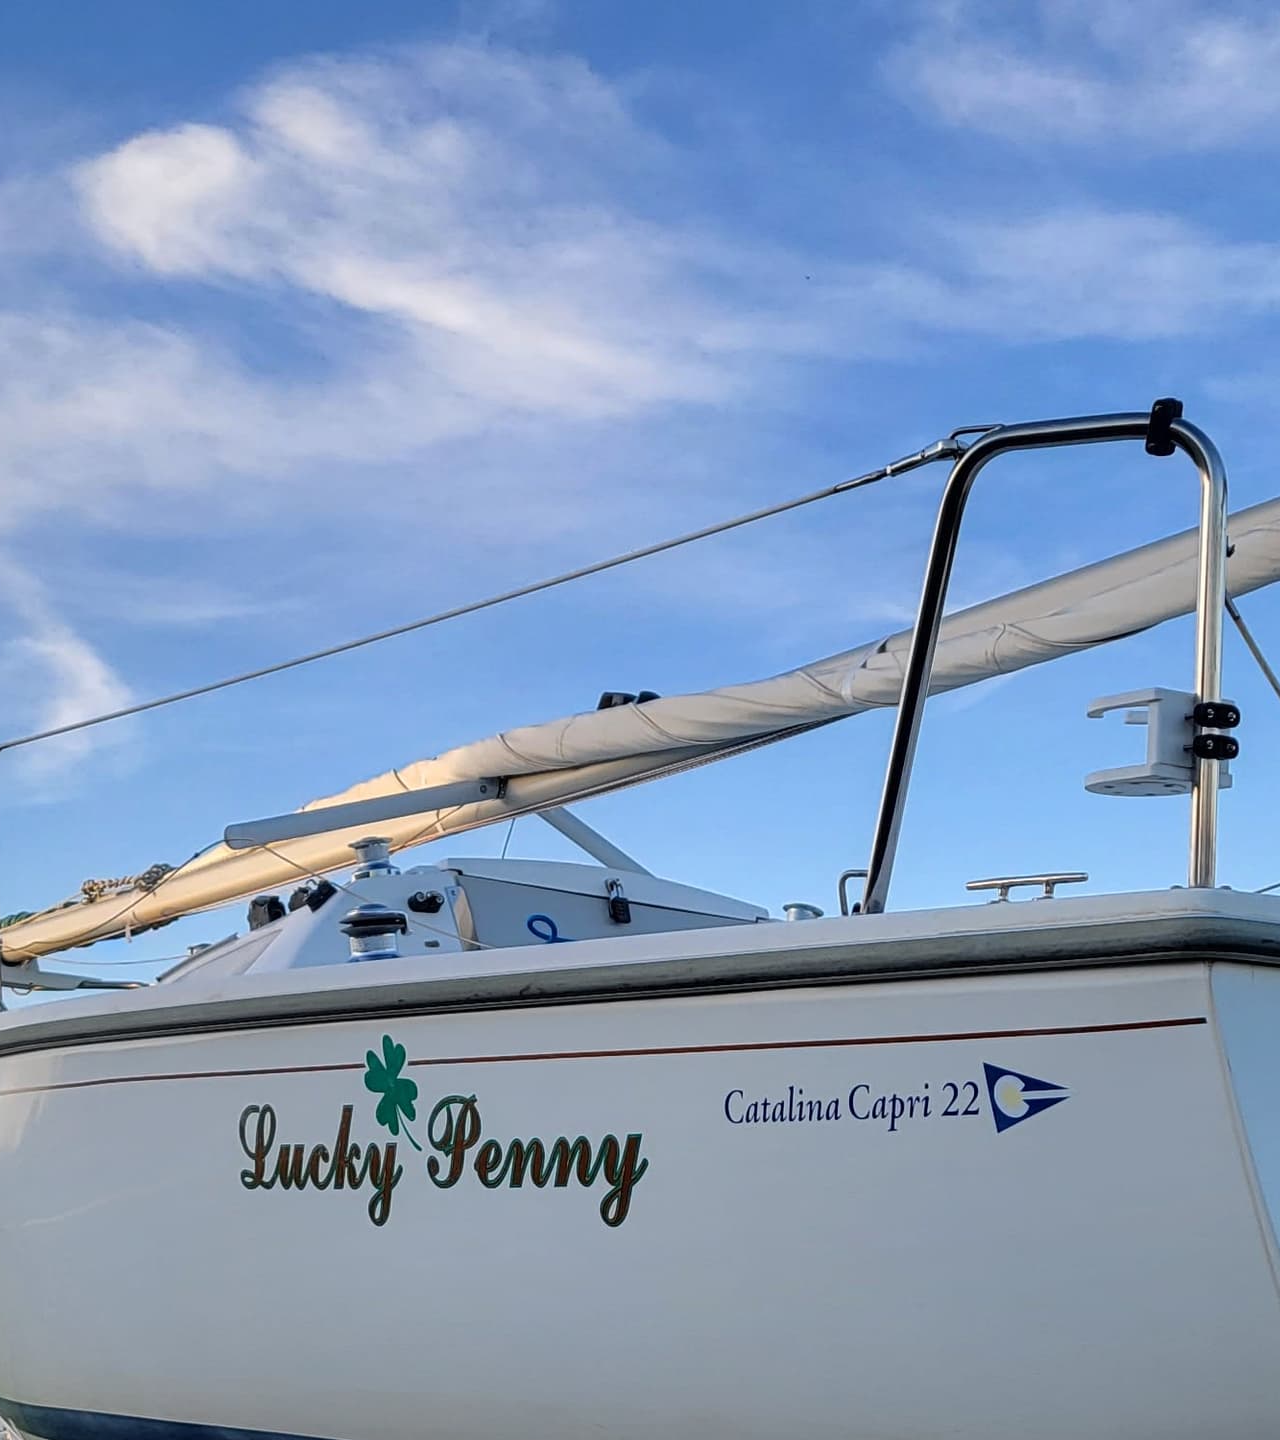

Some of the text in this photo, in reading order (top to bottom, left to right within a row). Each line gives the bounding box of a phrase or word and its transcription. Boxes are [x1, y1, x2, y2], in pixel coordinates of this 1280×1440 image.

[724, 1081, 980, 1132] Catalina Capri 22
[238, 1093, 650, 1228] Lucky Penny
